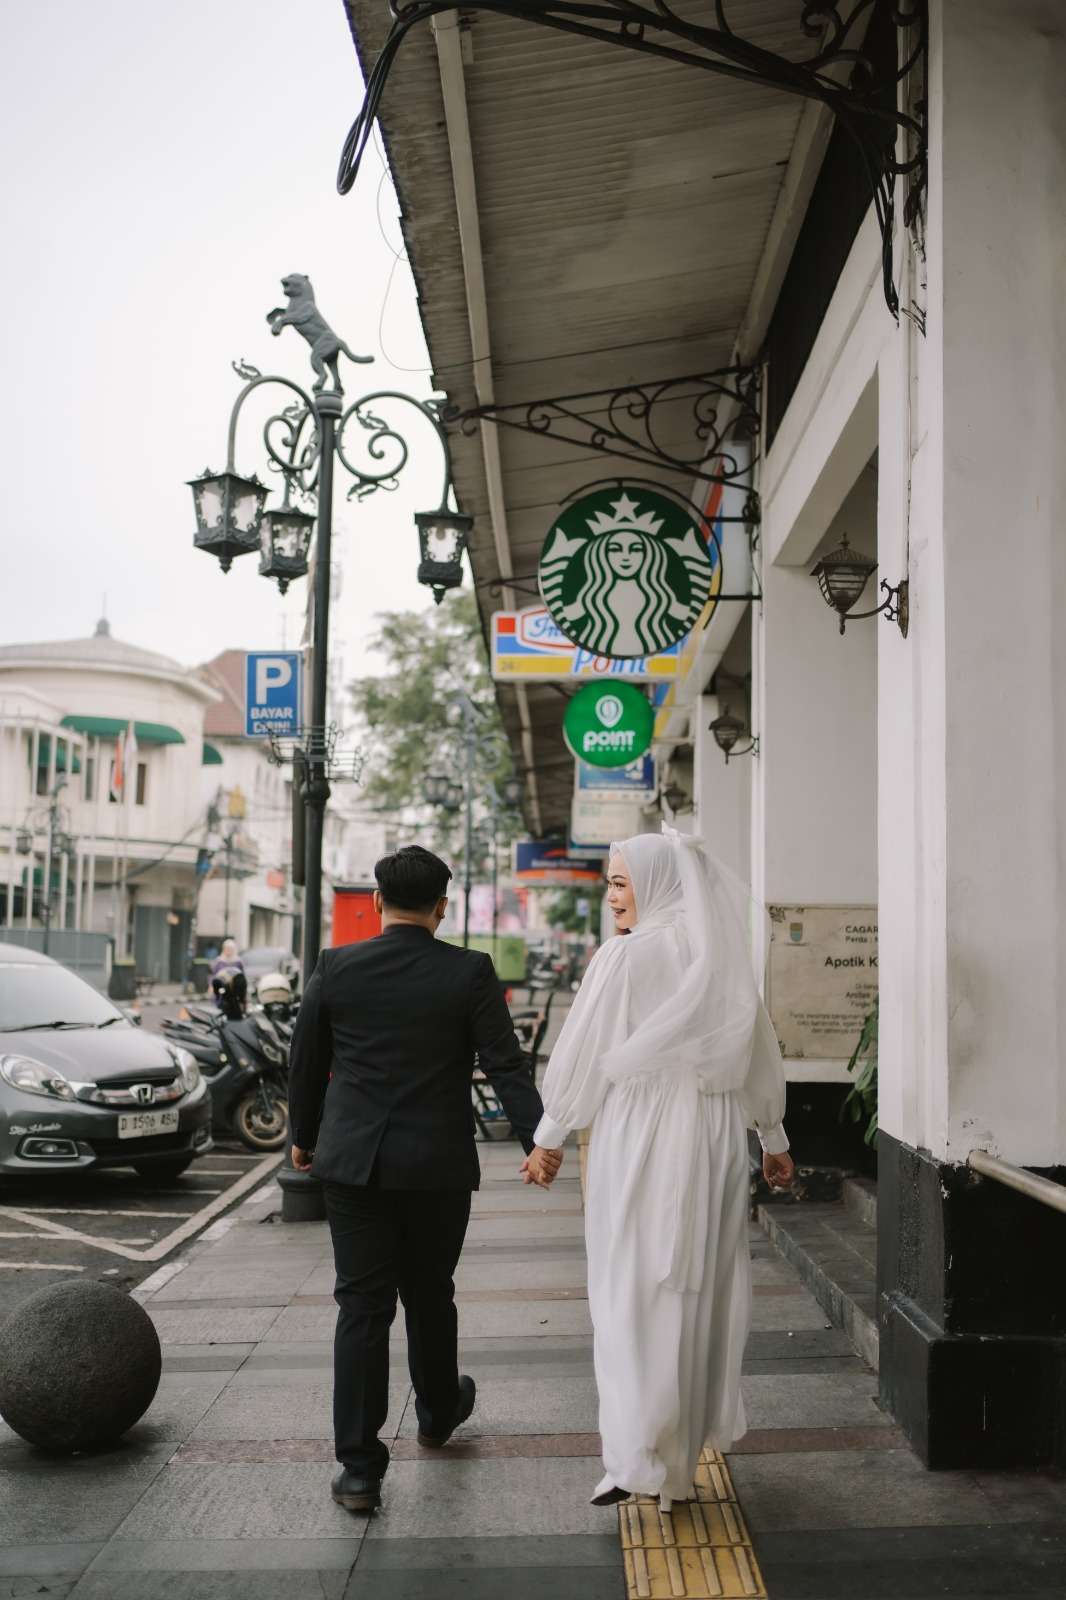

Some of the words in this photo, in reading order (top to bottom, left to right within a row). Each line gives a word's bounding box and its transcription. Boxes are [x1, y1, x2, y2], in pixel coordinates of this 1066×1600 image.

[256, 658, 292, 705] P
[251, 707, 293, 719] BAYAR
[845, 925, 878, 934] CAGAR
[824, 956, 865, 969] Apotik
[121, 1117, 128, 1130] D
